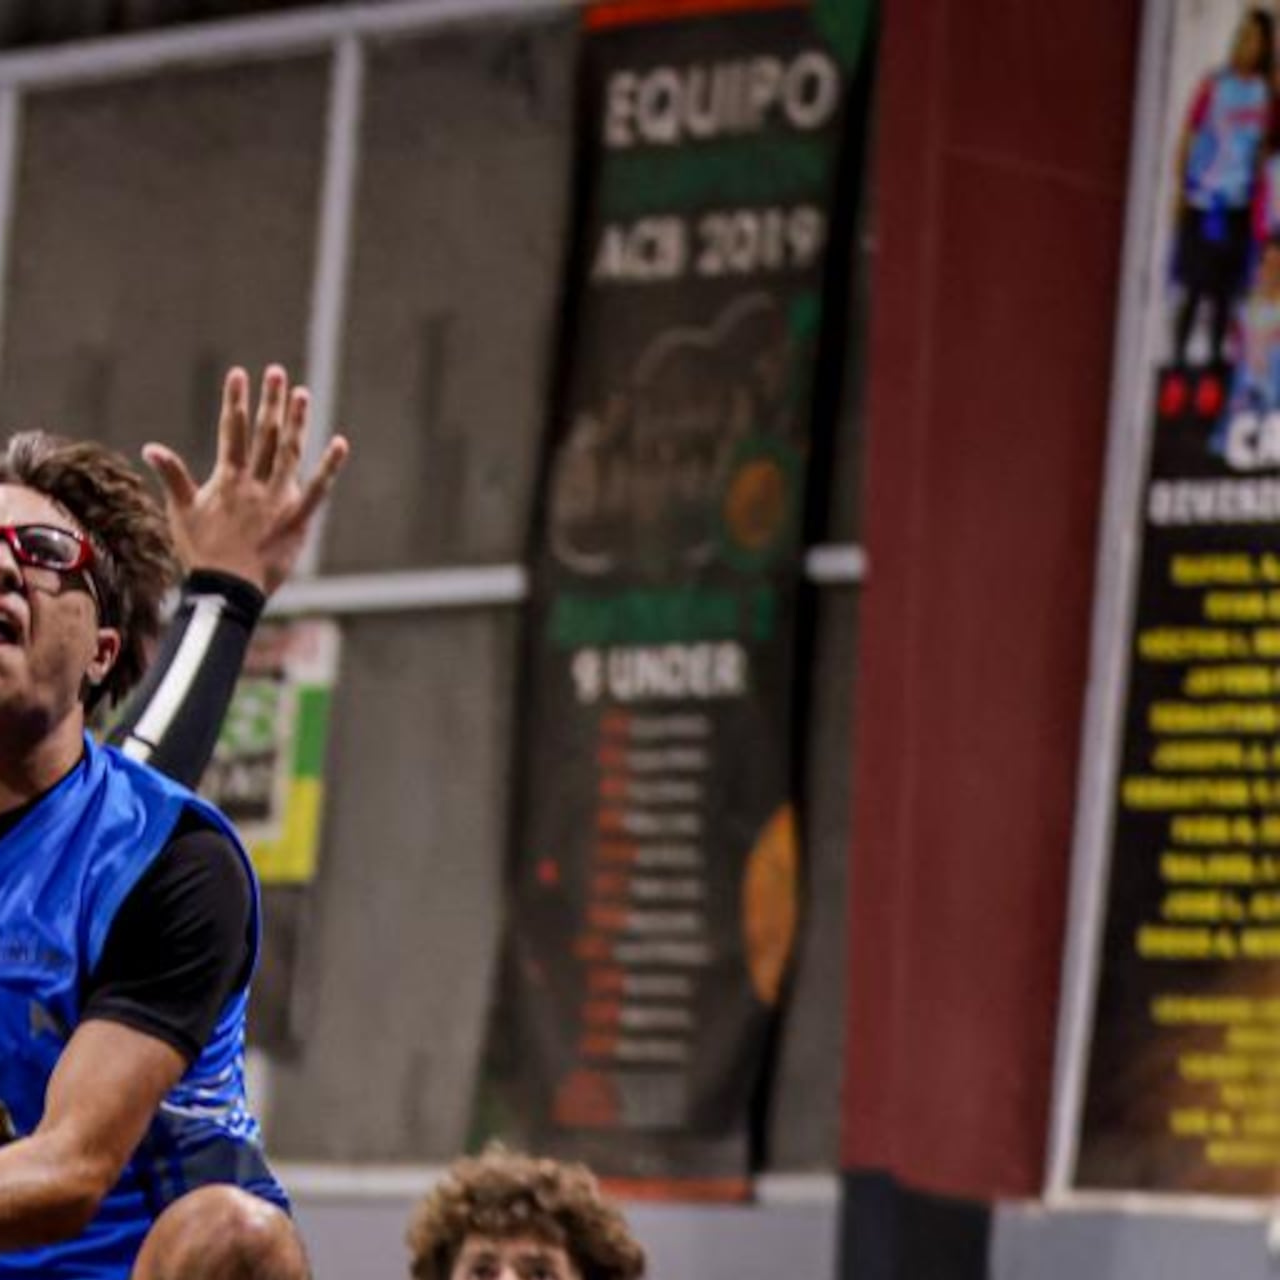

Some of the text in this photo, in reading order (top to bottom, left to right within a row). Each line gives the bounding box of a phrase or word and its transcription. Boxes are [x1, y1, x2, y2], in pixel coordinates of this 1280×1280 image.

[604, 51, 838, 148] EQUIPO
[695, 206, 824, 276] 2019
[607, 640, 745, 699] UNDER
